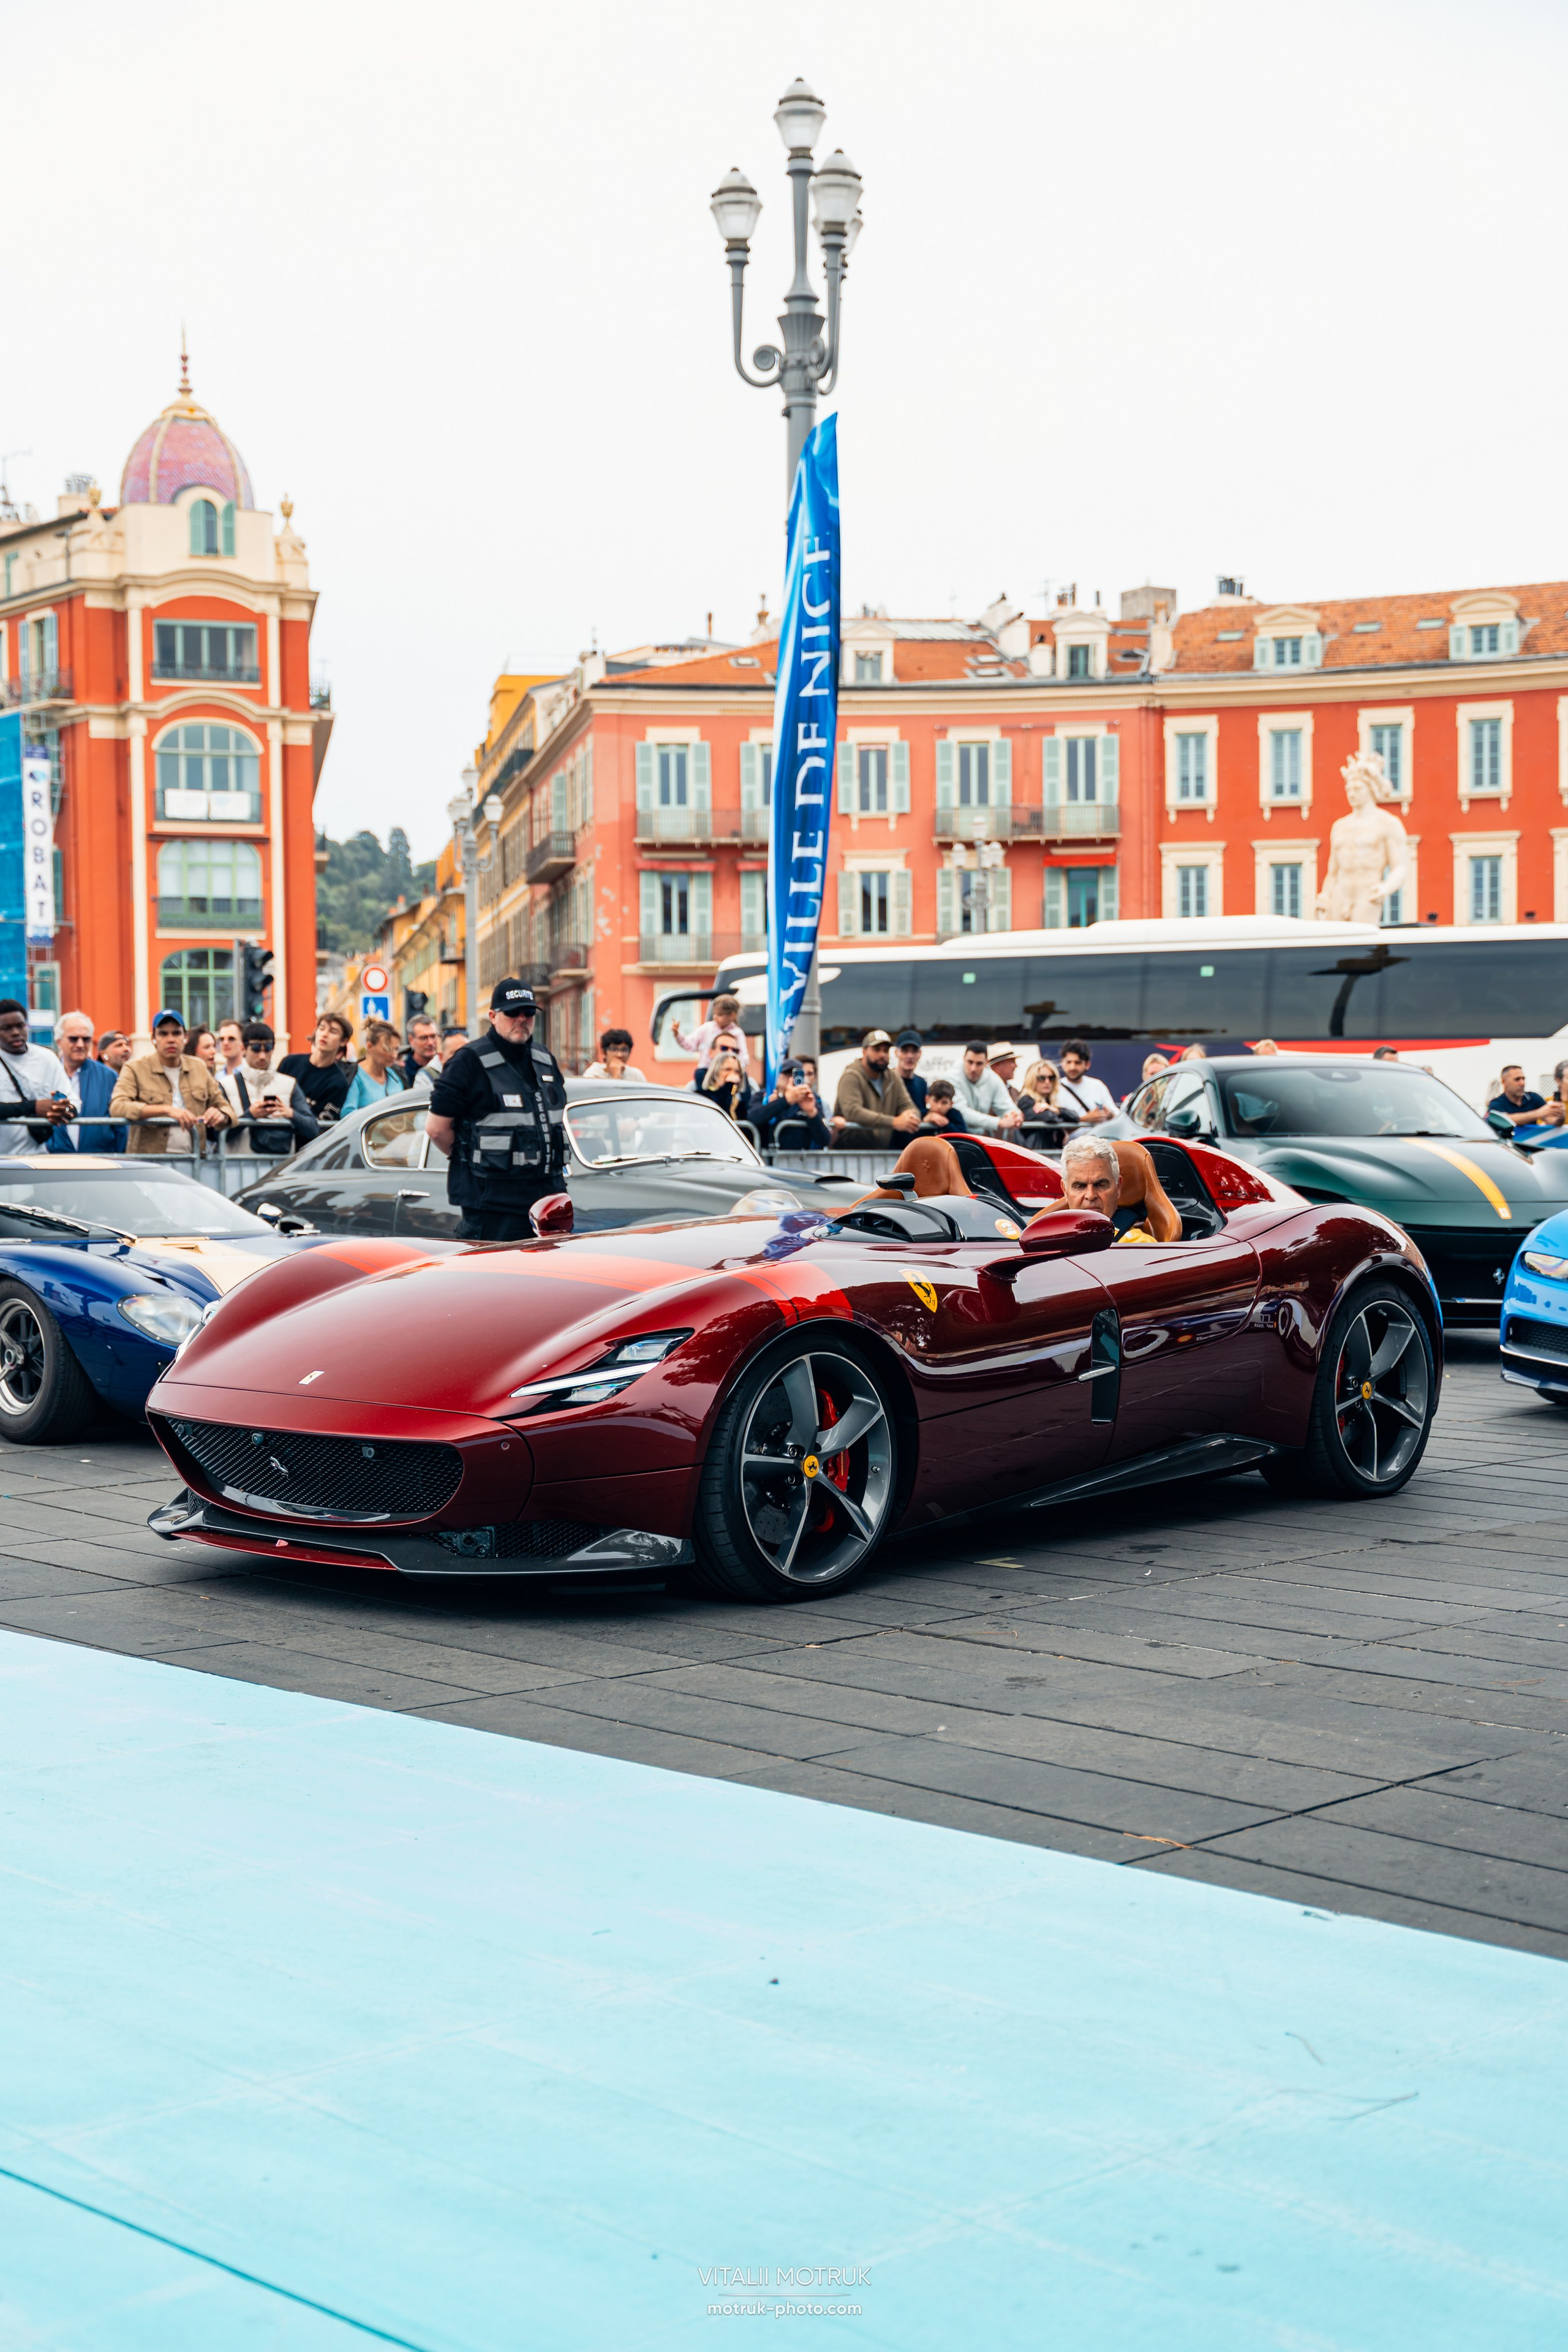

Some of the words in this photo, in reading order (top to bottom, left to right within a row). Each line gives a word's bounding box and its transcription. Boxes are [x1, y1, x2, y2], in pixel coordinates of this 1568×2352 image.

[31, 791, 47, 918] ROBAT
[778, 829, 824, 1005] VILLE
[535, 1091, 551, 1174] SECURITE
